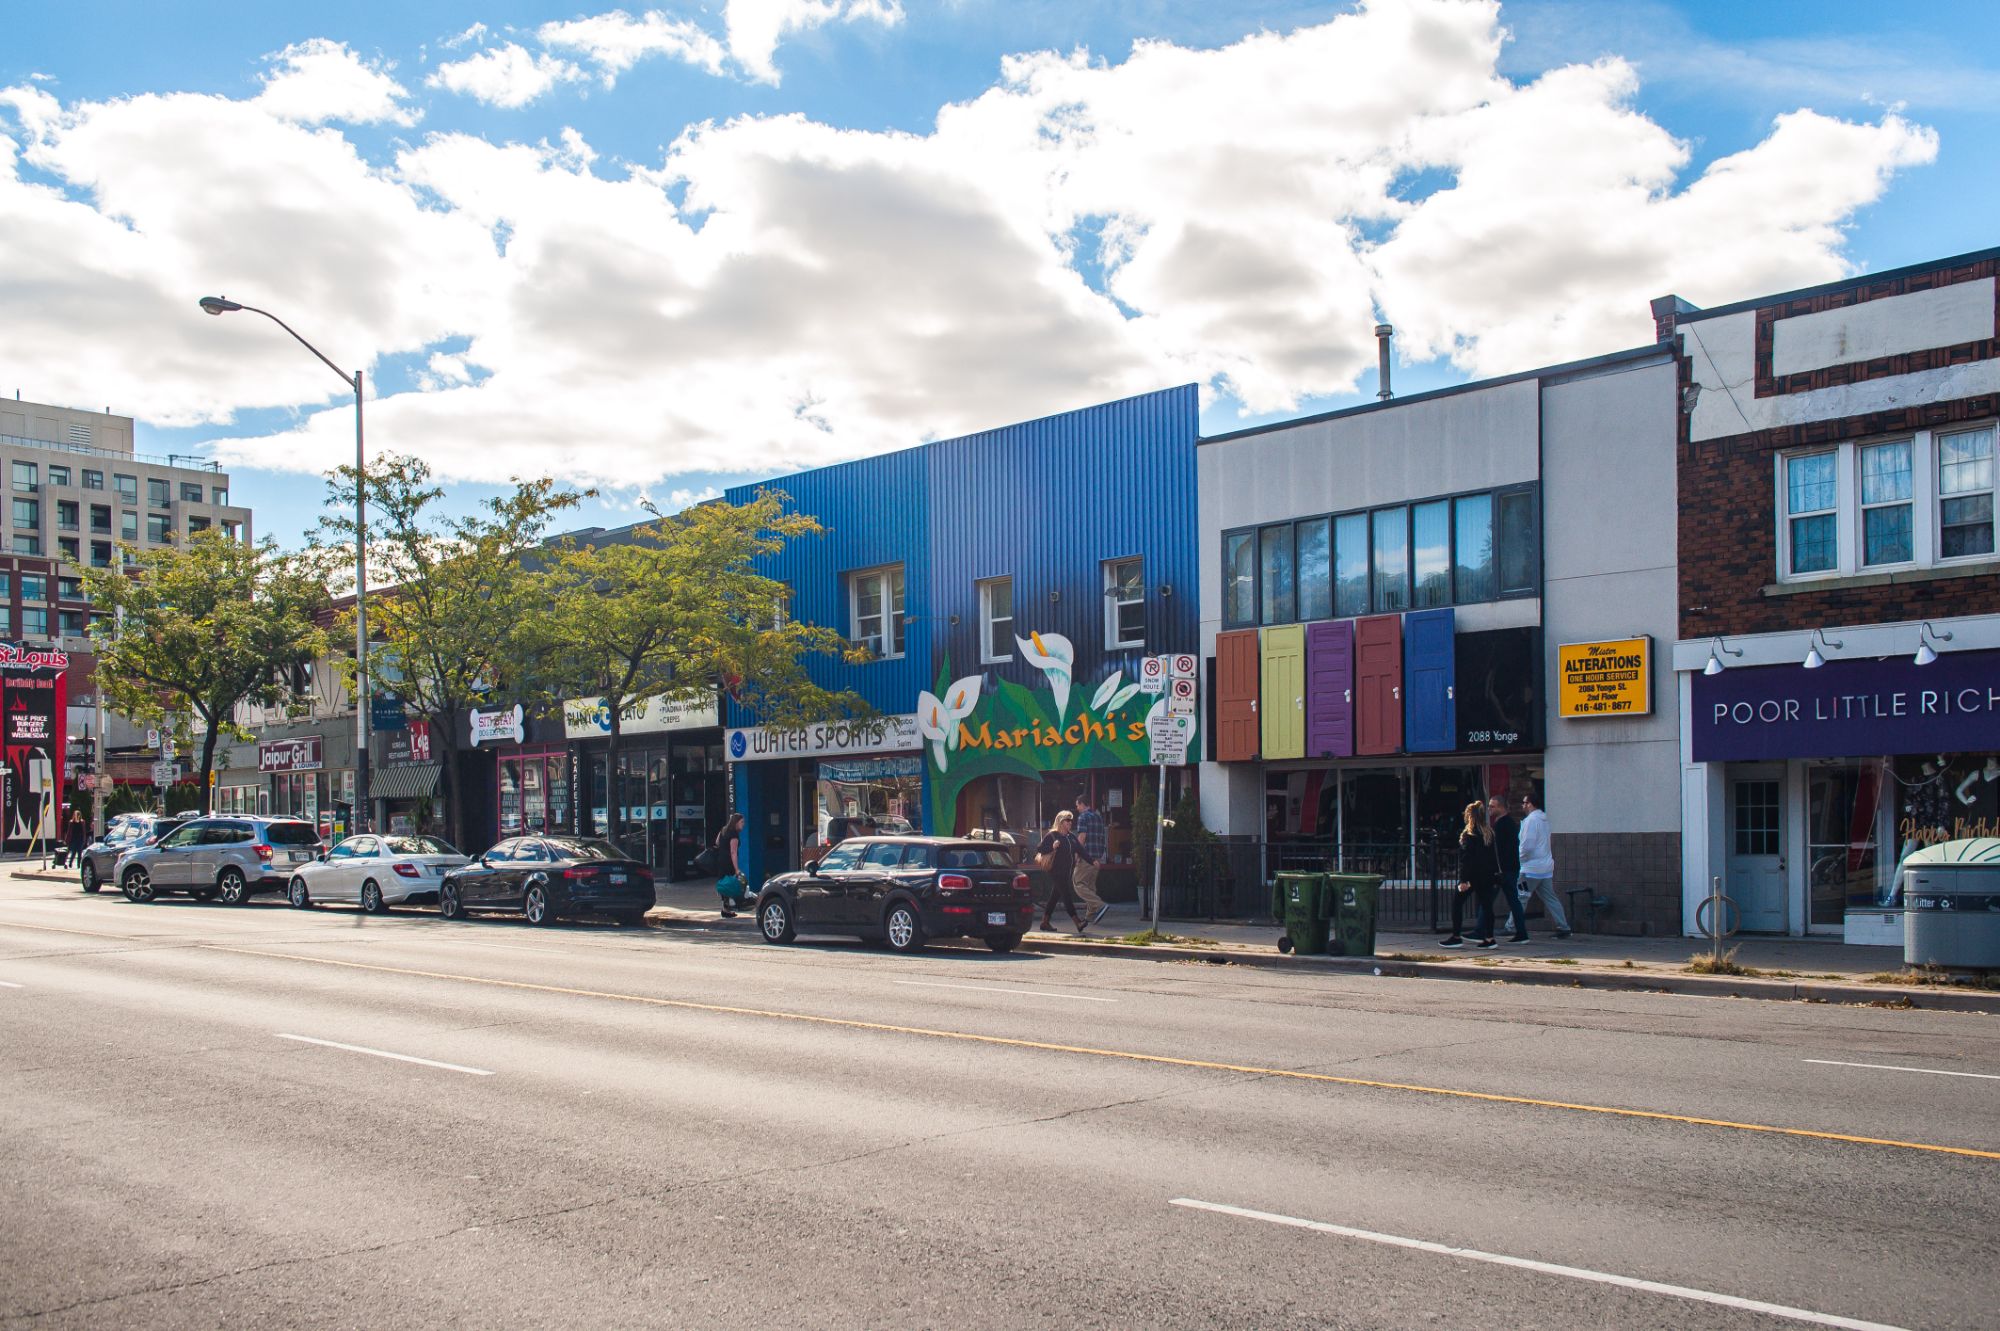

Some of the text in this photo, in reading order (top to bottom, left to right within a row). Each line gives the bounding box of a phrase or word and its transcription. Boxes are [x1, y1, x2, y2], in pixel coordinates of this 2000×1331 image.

[16, 647, 69, 668] Louis
[1587, 646, 1616, 656] Mister
[1565, 655, 1642, 673] ALTERATIONS
[1569, 671, 1637, 683] ONE HOUR SERVICE
[1578, 685, 1595, 693] 2088
[1597, 684, 1617, 692] Yonge
[1587, 693, 1618, 701] 2nd Floor
[1714, 699, 1800, 725] POOR
[1815, 692, 1907, 720] LITTLE
[663, 715, 680, 724] CREPES
[958, 711, 1147, 751] Mariachi's
[1468, 730, 1518, 744] 2088 Yonge
[753, 723, 883, 754] WATER SPORTS
[896, 739, 912, 748] Swim
[260, 740, 313, 770] Jaipur Grill
[1915, 897, 1935, 908] Litter
